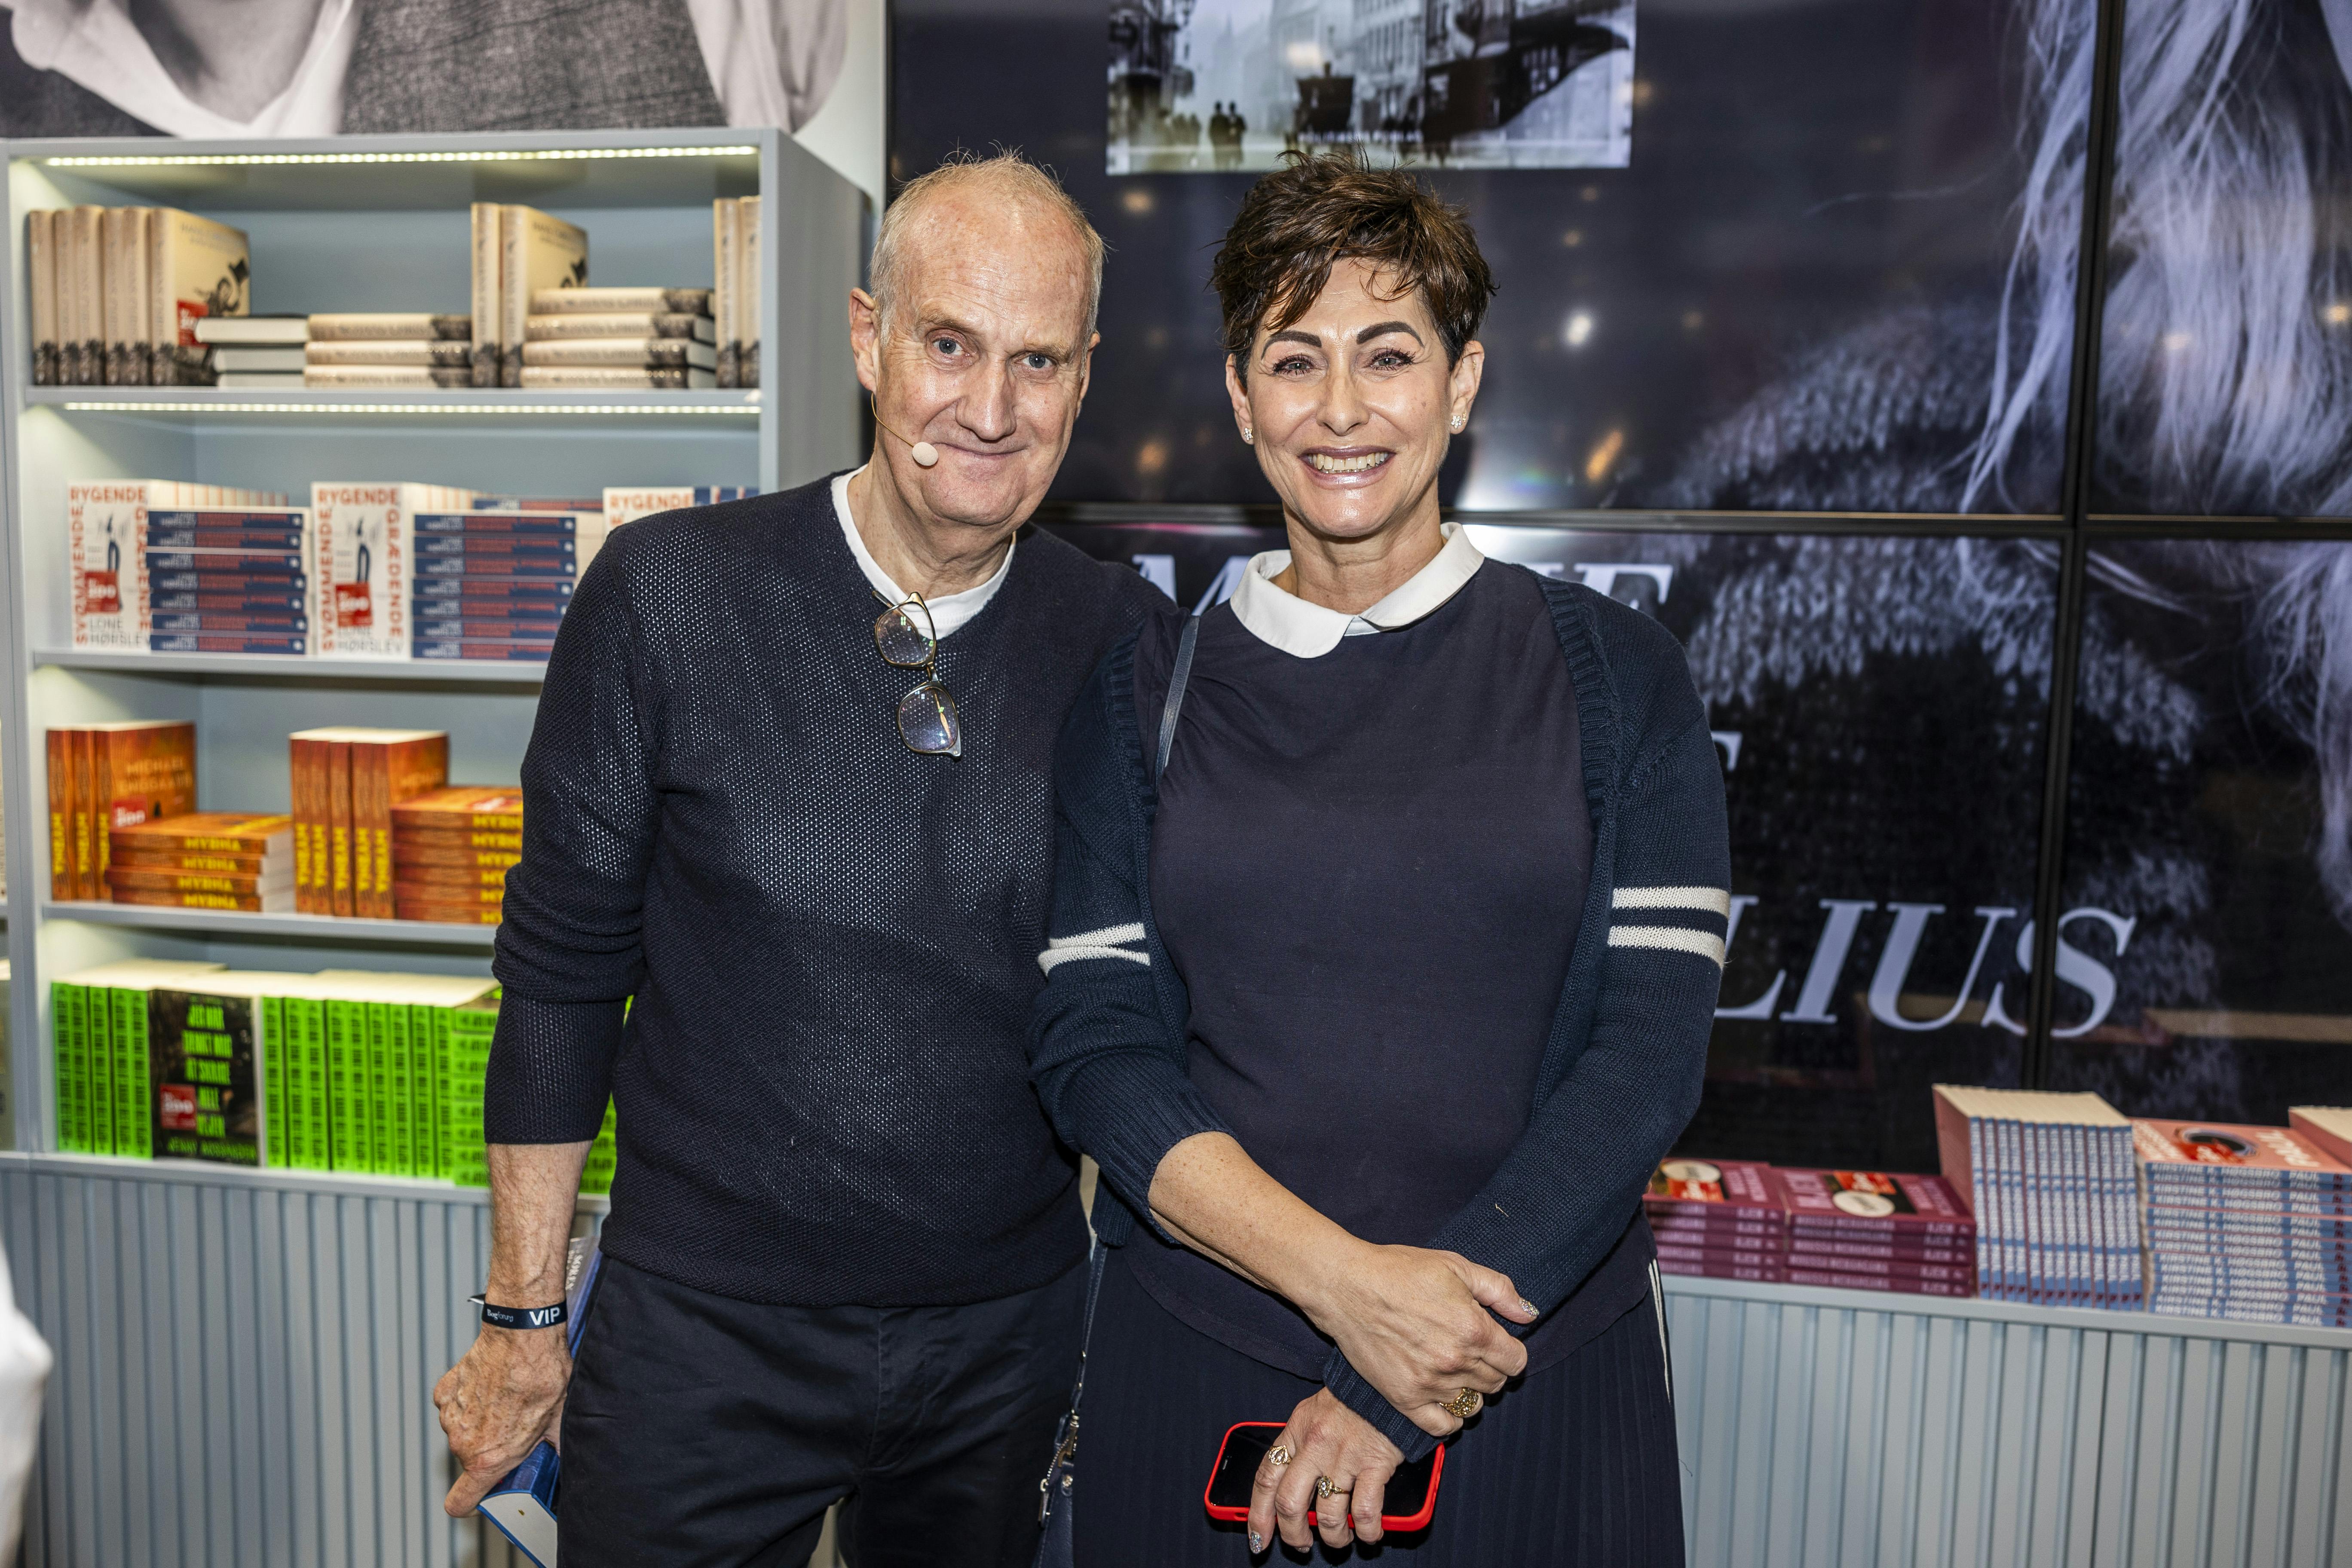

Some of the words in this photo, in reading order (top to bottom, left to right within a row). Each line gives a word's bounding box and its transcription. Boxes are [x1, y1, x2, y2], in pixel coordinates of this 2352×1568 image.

[71, 486, 146, 502] RYGENDE
[318, 488, 398, 506] RYGENDE
[2151, 1163, 2203, 1174] KIRSTINE
[2289, 1170, 2318, 1180] PAUL
[2154, 1184, 2205, 1195] KIRSTINE
[2289, 1191, 2319, 1202] PAUL
[2156, 1195, 2207, 1206] KIRSTINE
[2291, 1203, 2321, 1214] PAUL
[2153, 1208, 2205, 1219] KIRSTINE
[2291, 1216, 2320, 1227] PAUL
[2154, 1219, 2205, 1230] KIRSTINE
[2291, 1227, 2320, 1238] PAUL
[2155, 1230, 2206, 1241] KIRSTINE
[2292, 1238, 2321, 1249] PAUL
[2155, 1241, 2206, 1253] KIRSTINE
[2291, 1250, 2321, 1260] PAUL
[2160, 1253, 2211, 1264] KIRSTINE
[2294, 1261, 2324, 1271] PAUL
[2161, 1264, 2212, 1275] KIRSTINE
[2296, 1271, 2326, 1282] PAUL
[2162, 1275, 2213, 1286] KIRSTINE
[2297, 1282, 2326, 1292] PAUL
[2162, 1286, 2213, 1297] KIRSTINE
[2297, 1293, 2327, 1303] PAUL
[2157, 1295, 2208, 1307] KIRSTINE
[2293, 1304, 2323, 1314] PAUL
[529, 1307, 561, 1326] VIP
[2156, 1305, 2207, 1317] KIRSTINE
[2292, 1314, 2322, 1325] PAUL
